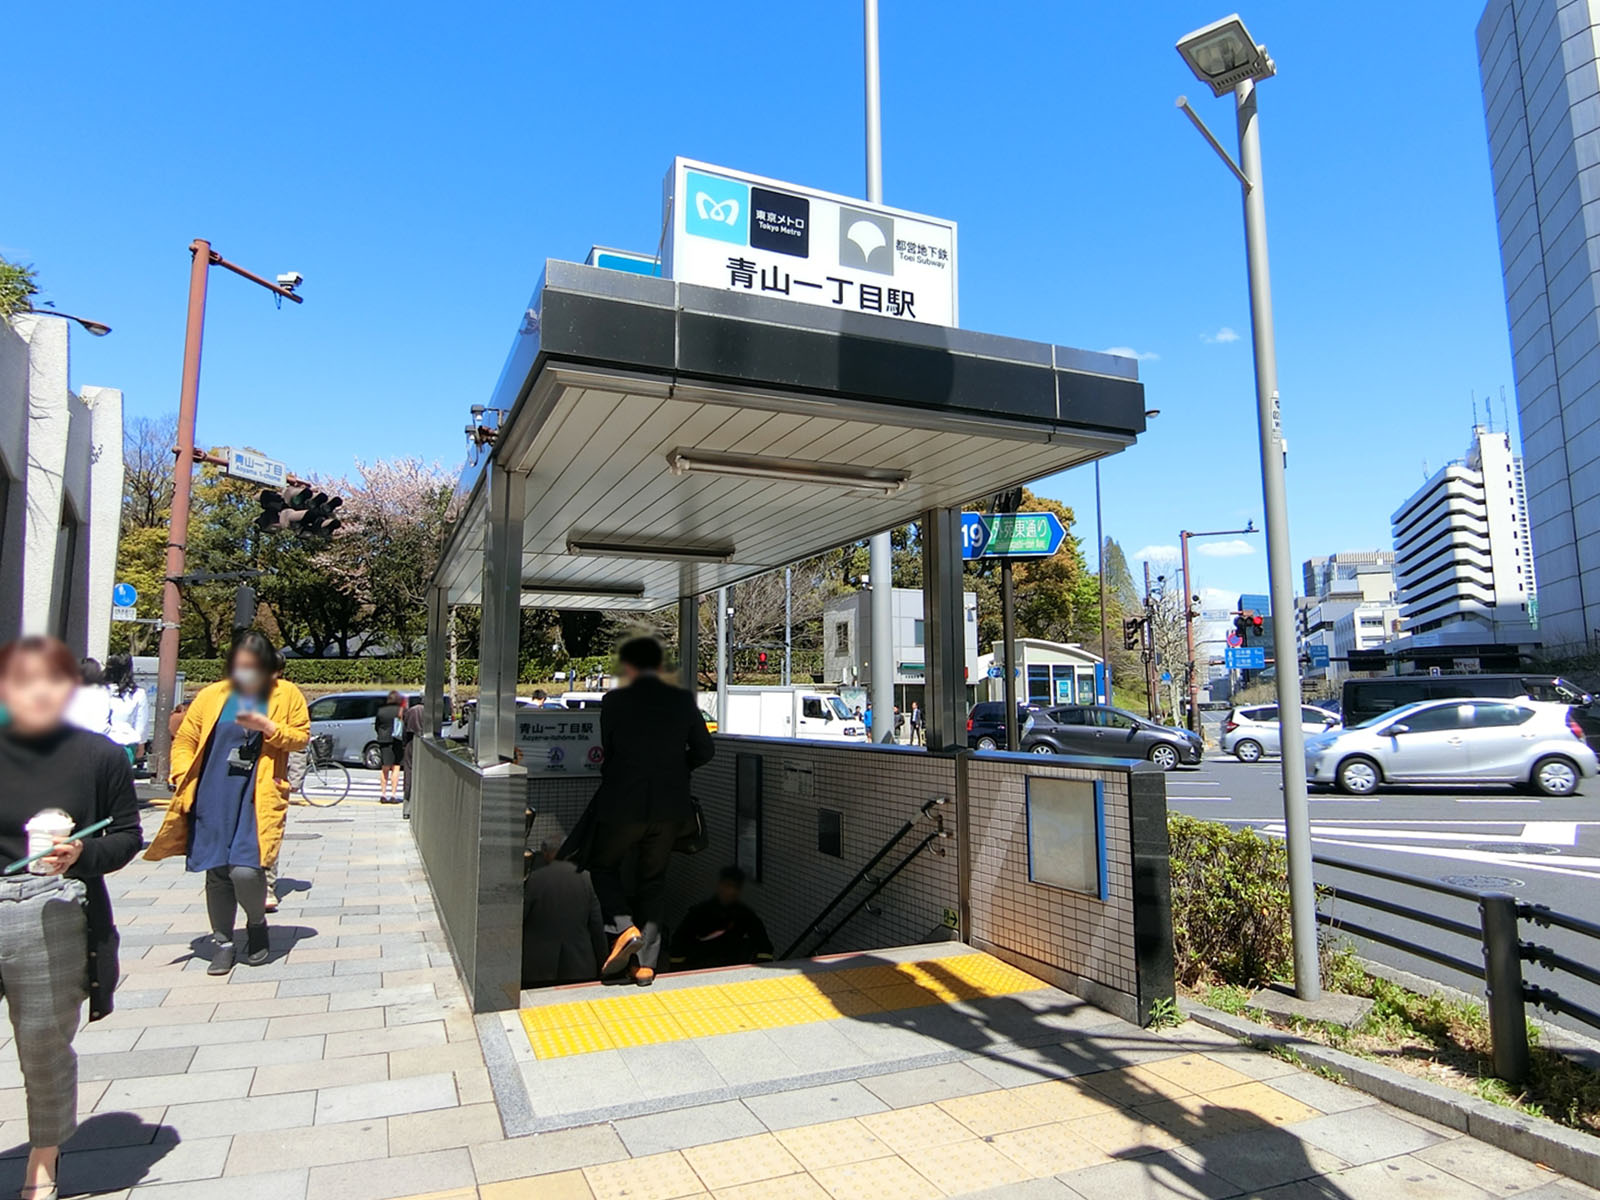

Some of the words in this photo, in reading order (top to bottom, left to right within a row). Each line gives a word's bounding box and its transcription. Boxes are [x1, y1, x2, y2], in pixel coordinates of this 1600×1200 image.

[755, 209, 805, 229] 東京メトロ
[758, 221, 780, 234] Tokyo
[780, 226, 802, 237] Metro
[896, 239, 949, 261] 都営地下鉄
[899, 252, 916, 262] Toei
[917, 255, 946, 269] Subway
[726, 257, 916, 319] 青山一丁目駅
[235, 454, 282, 476] 青山一丁目
[519, 722, 594, 734] 青山一丁目駅
